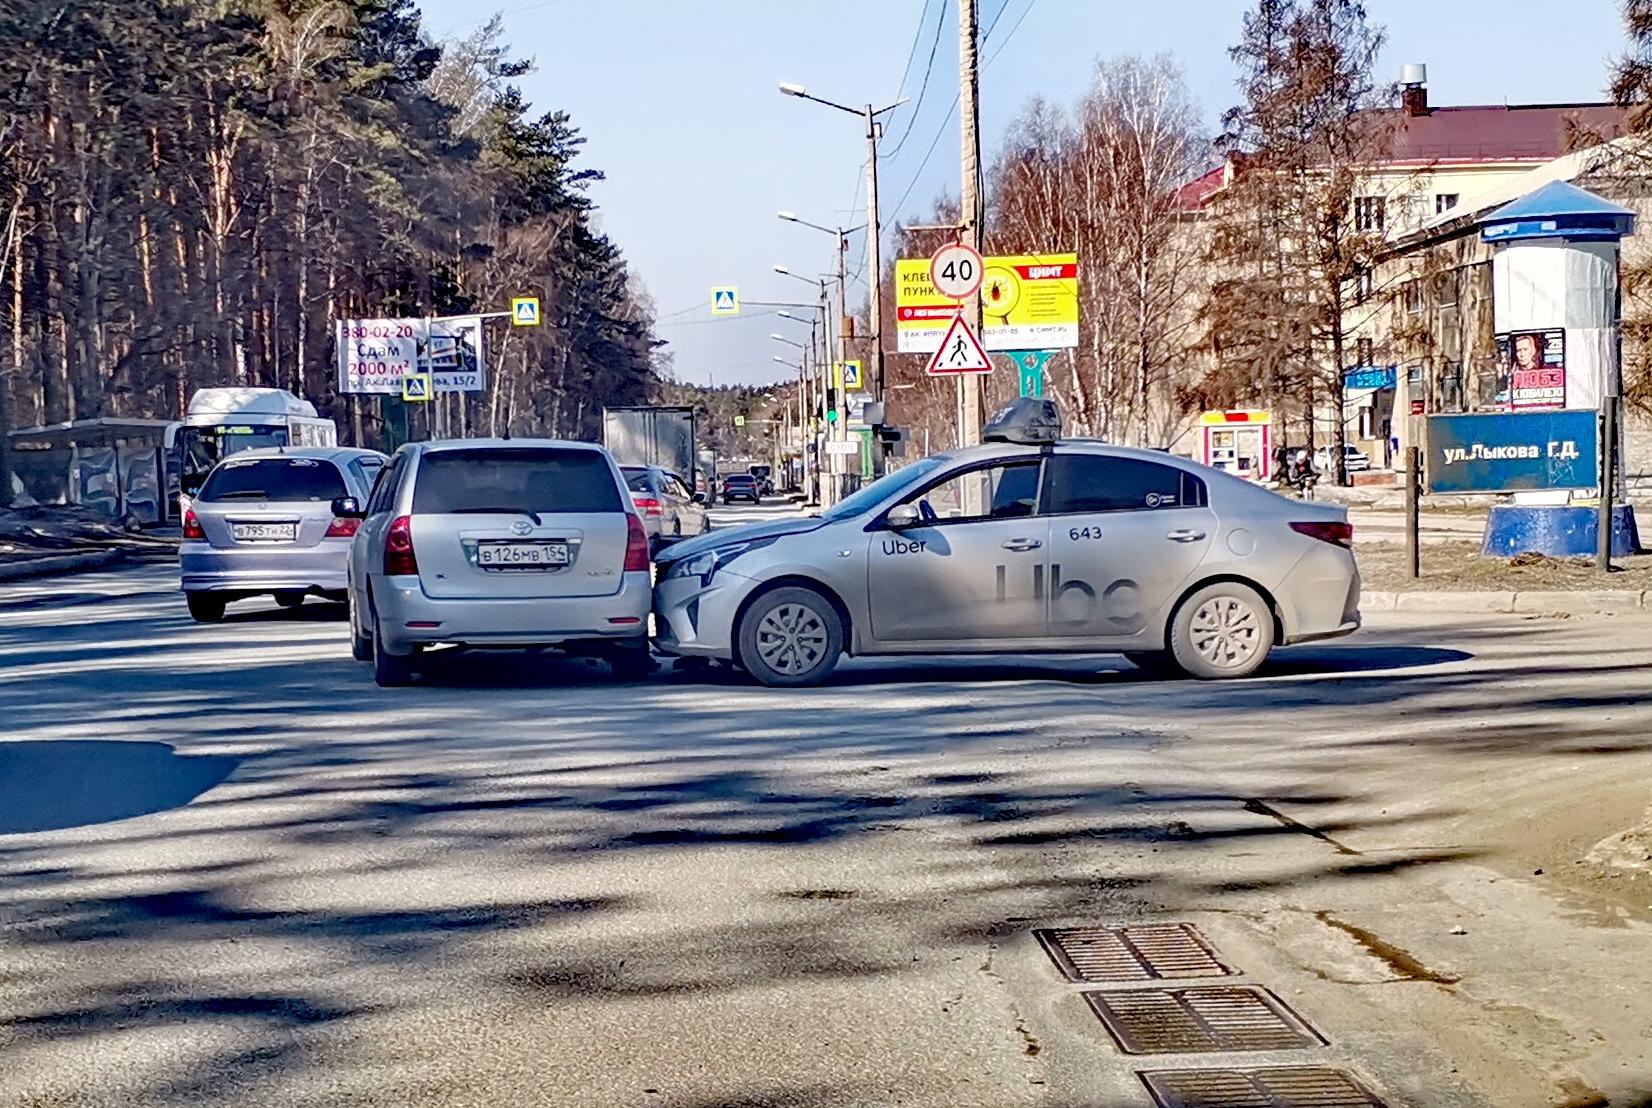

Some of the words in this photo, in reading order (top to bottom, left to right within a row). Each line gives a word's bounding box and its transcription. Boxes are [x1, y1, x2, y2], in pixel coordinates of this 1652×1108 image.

[941, 259, 972, 281] 40
[342, 325, 412, 338] 380-02-20
[357, 343, 400, 359] Сдам
[349, 361, 386, 375] 2000
[1547, 441, 1580, 460] Г.Д.
[1069, 526, 1103, 541] 643
[882, 539, 927, 556] Uber
